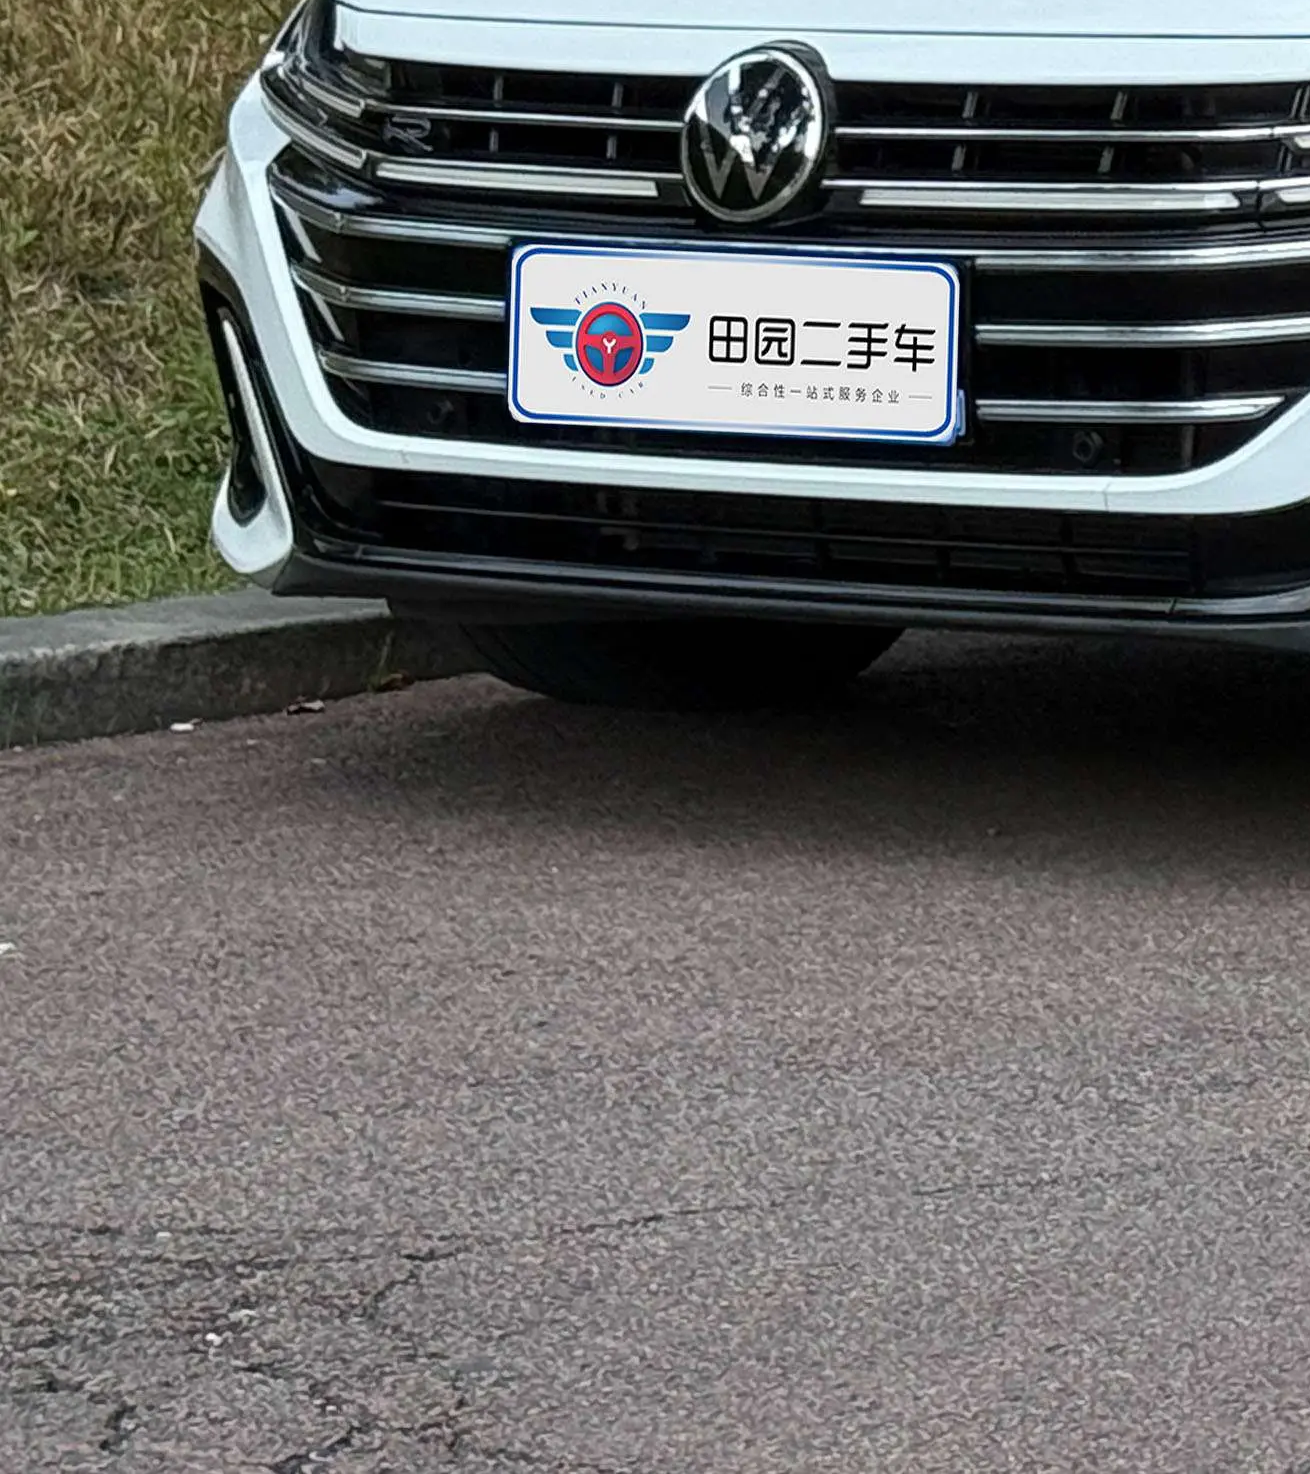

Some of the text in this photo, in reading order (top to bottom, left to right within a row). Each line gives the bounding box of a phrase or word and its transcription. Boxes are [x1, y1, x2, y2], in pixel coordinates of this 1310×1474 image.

[708, 315, 936, 372] 田园二手车
[741, 382, 900, 403] 综合性一站式服务企业
